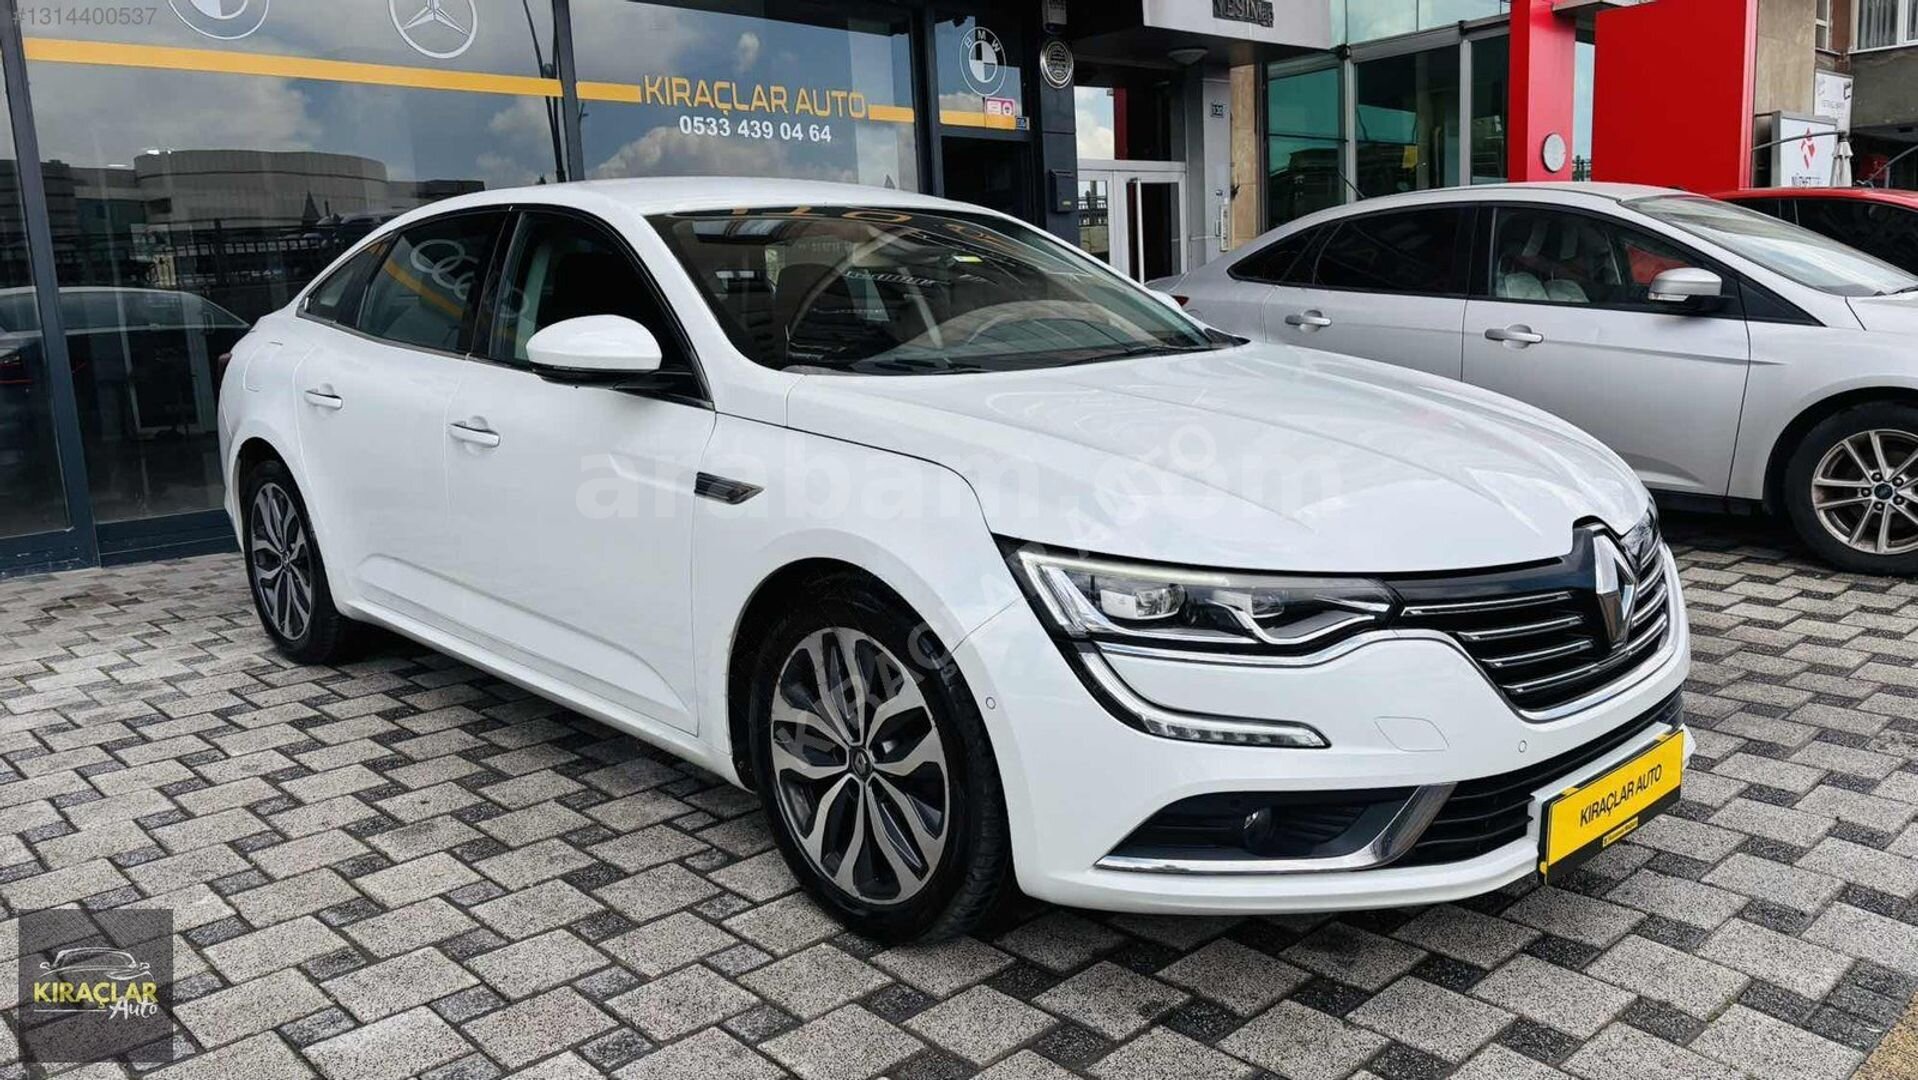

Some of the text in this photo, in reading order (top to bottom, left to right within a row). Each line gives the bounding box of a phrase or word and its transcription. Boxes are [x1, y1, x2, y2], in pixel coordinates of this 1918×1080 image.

[643, 75, 867, 119] KIRAÇLAR AUTO
[679, 115, 832, 143] 0533 439 04 64
[1580, 764, 1663, 827] KIRAÇLAR AUTO
